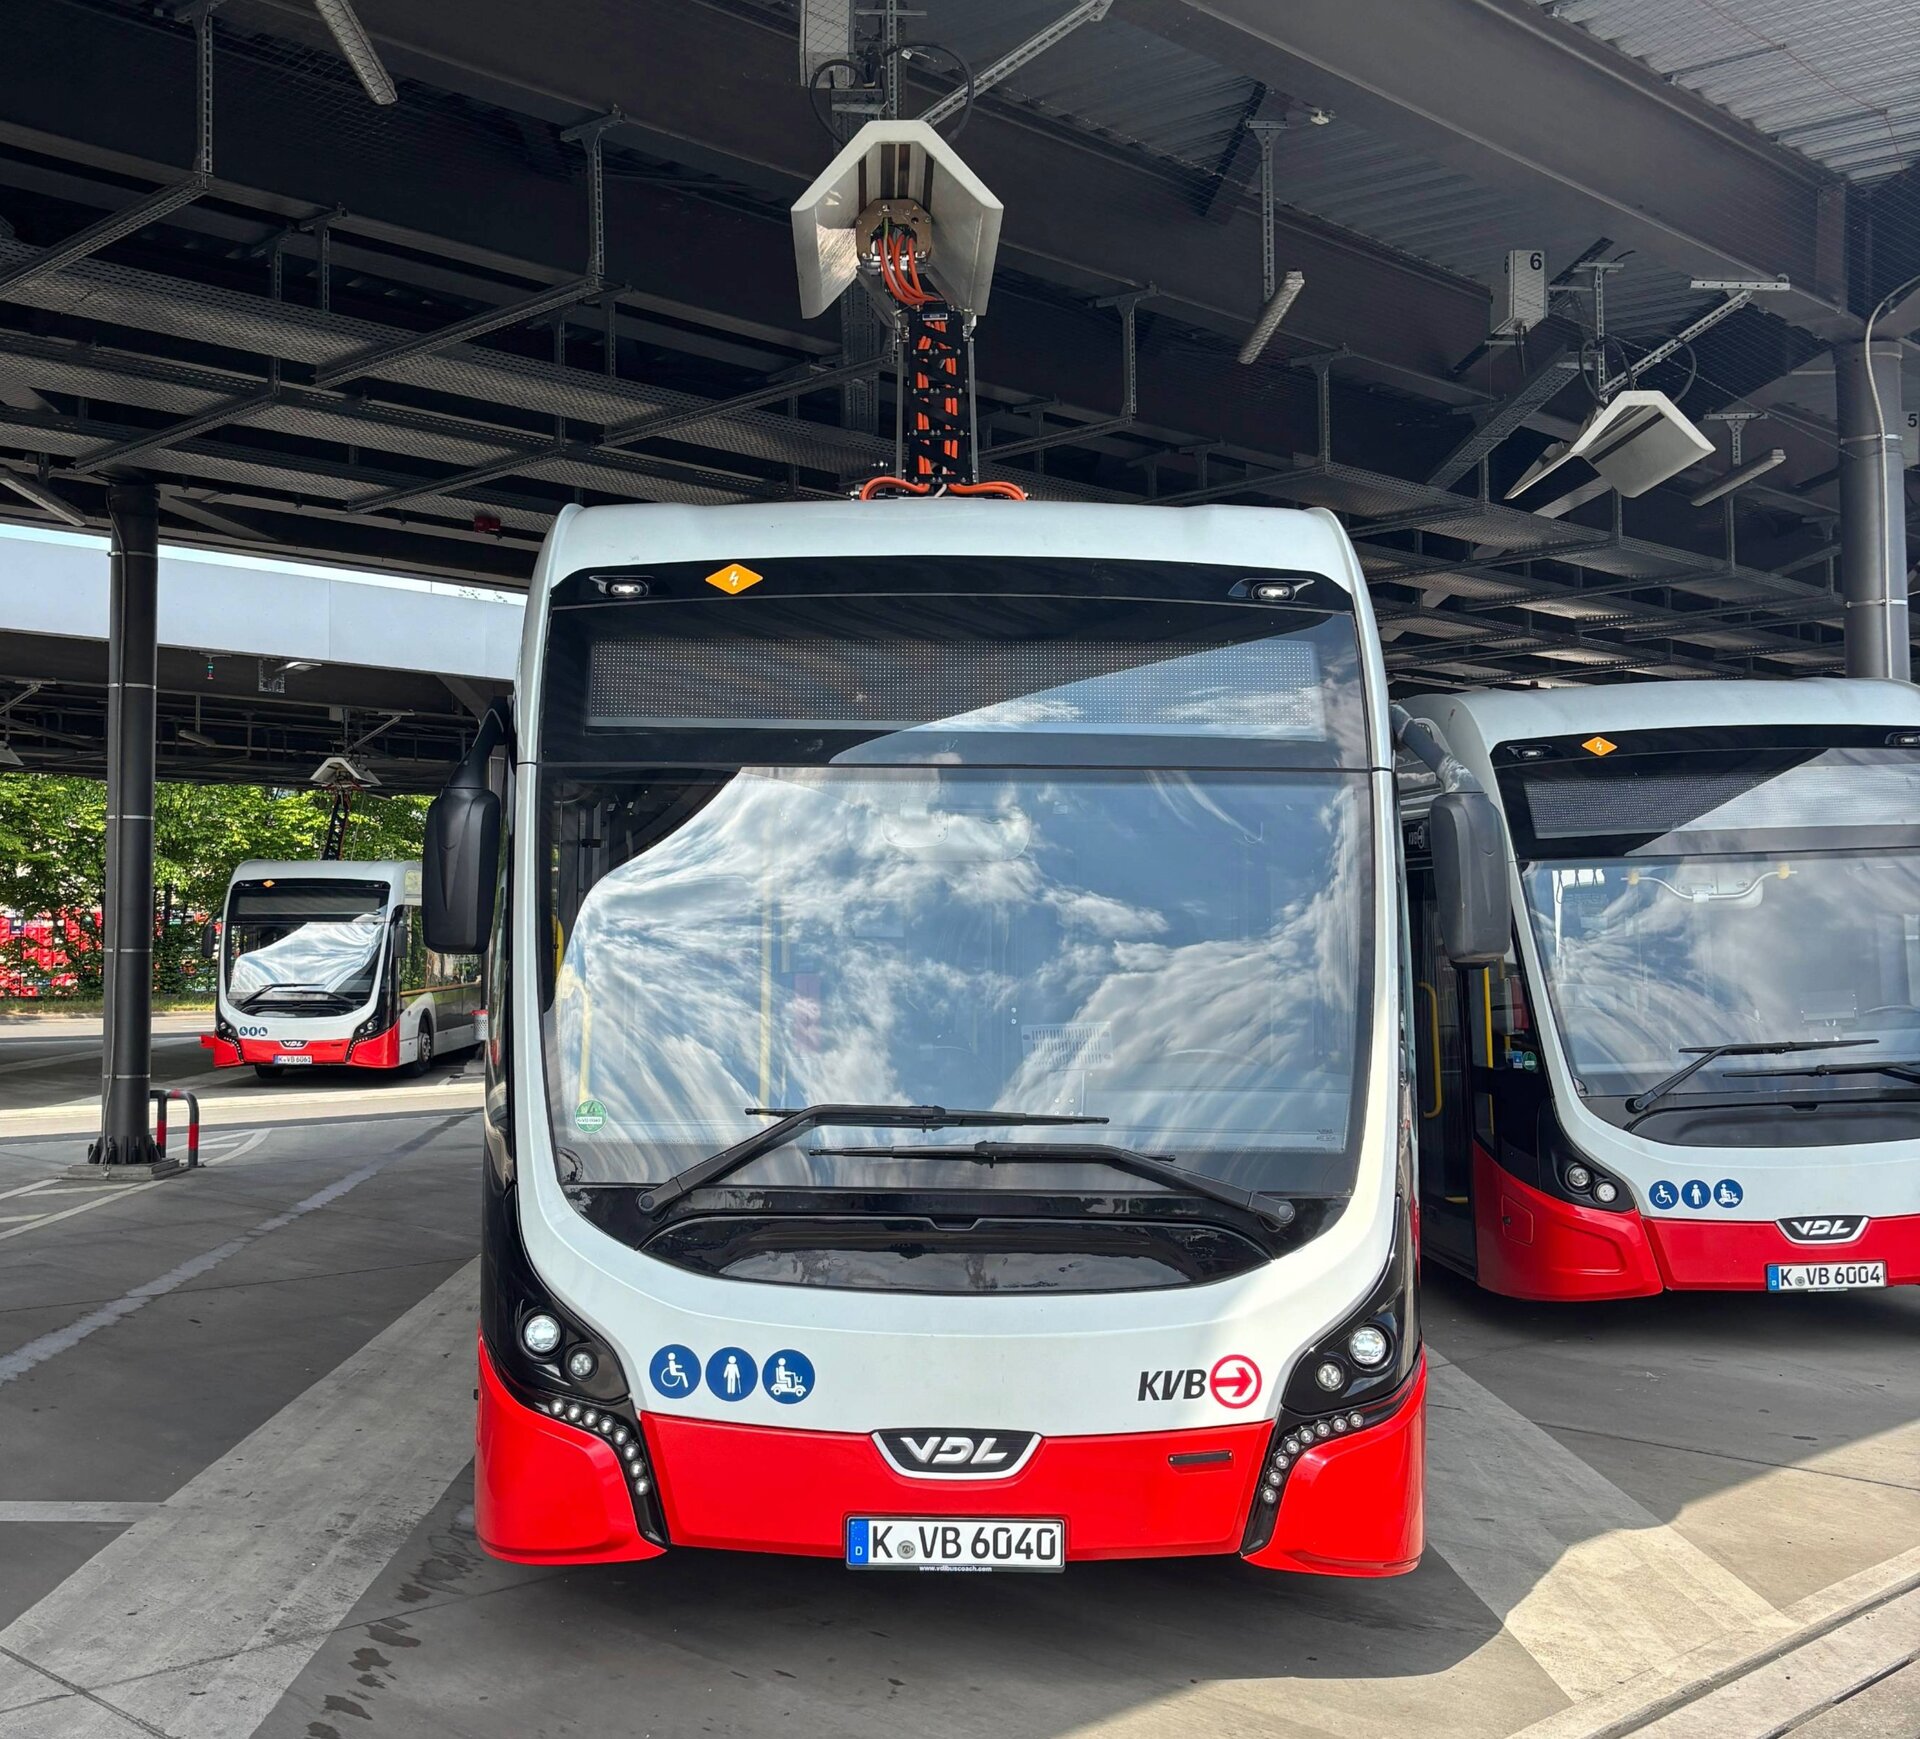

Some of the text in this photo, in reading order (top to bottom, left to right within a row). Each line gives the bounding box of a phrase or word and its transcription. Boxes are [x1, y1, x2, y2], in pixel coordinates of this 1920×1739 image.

[1530, 252, 1543, 271] 6
[1908, 413, 1918, 428] 5
[1791, 1219, 1851, 1236] VDL
[1780, 1268, 1793, 1287] K
[1805, 1267, 1830, 1286] VB
[1834, 1265, 1880, 1285] 6004
[1137, 1368, 1207, 1402] KVB
[900, 1436, 1008, 1465] VDL
[855, 1525, 1056, 1560] D K VB 6040
[919, 1565, 992, 1573] www.vdlbuscoach.com
